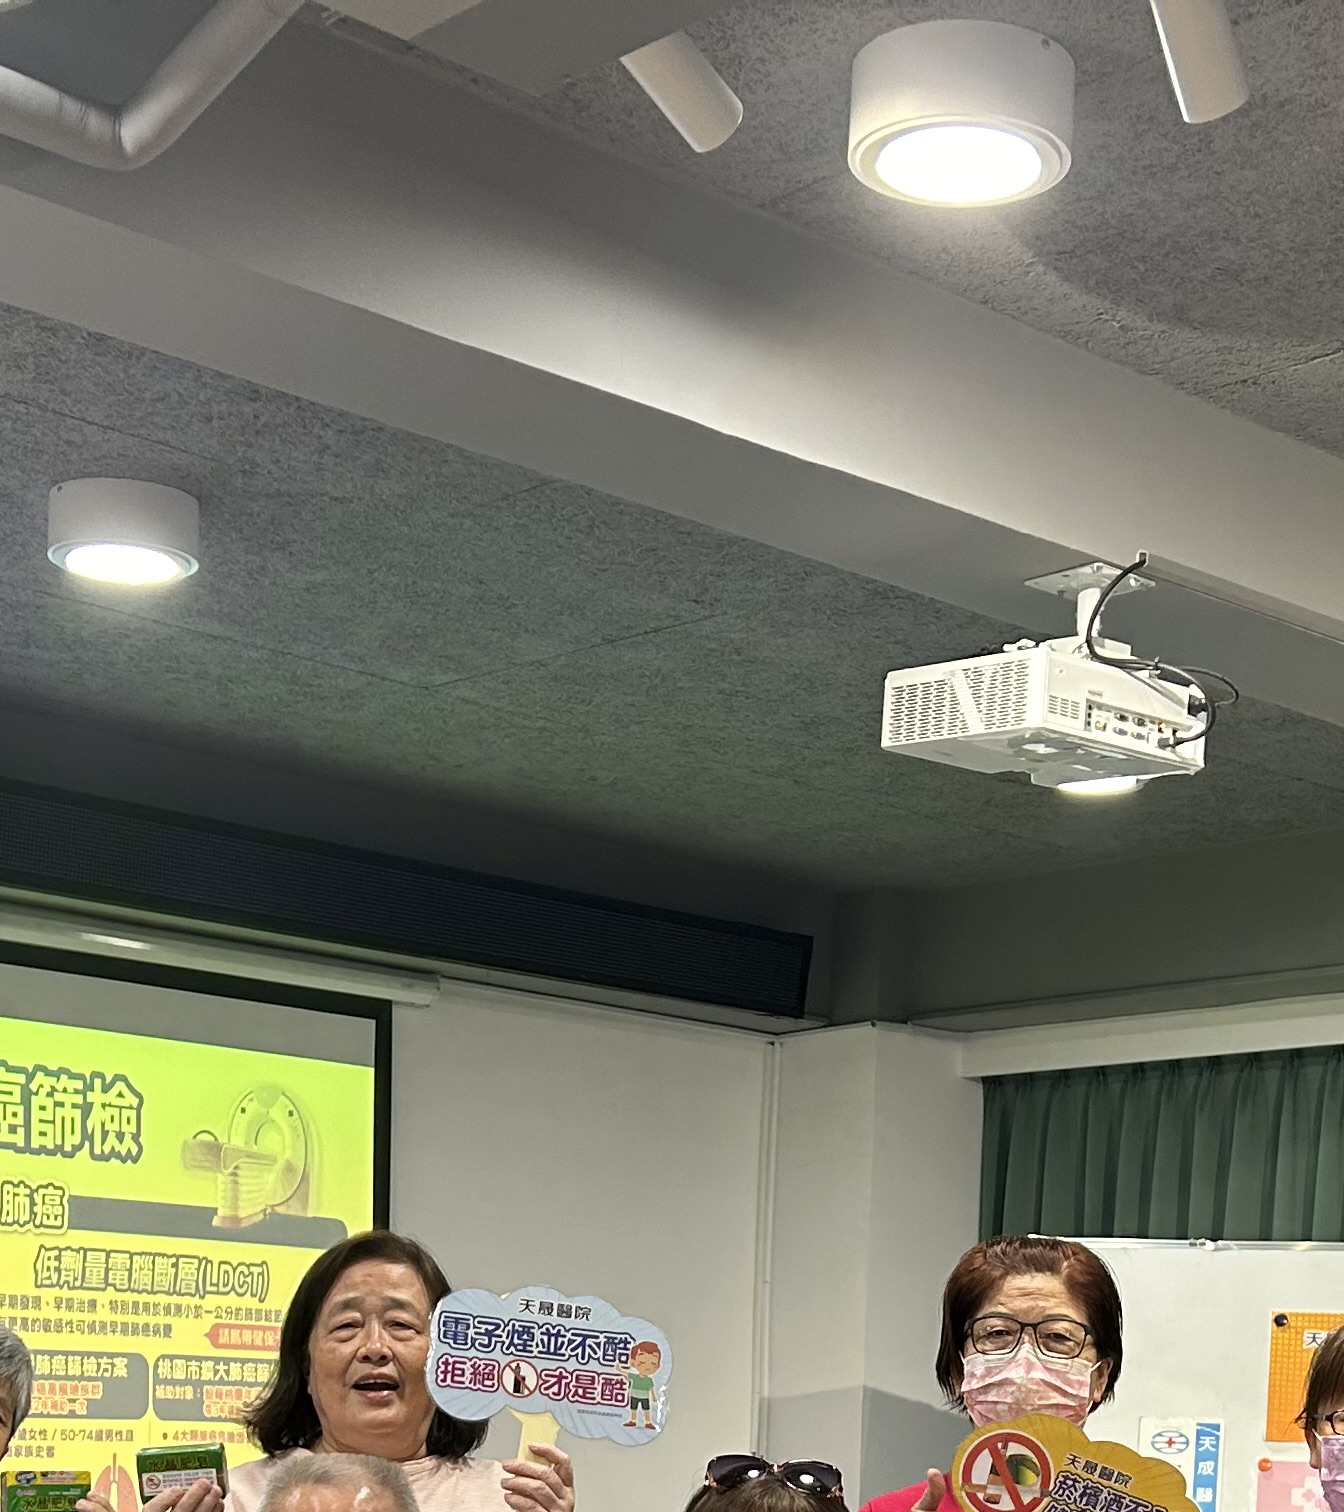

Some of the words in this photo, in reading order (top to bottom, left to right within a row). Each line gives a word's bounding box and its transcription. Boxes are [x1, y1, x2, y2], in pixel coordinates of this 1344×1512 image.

[518, 1297, 593, 1322] 天晟醫院
[438, 1310, 636, 1369] 電子煙並不酷
[30, 1354, 128, 1377] 肺癌篩檢方案
[435, 1354, 501, 1391] 拒絕
[539, 1367, 631, 1408] 才是酷
[1064, 1452, 1133, 1489] 天晟醫院
